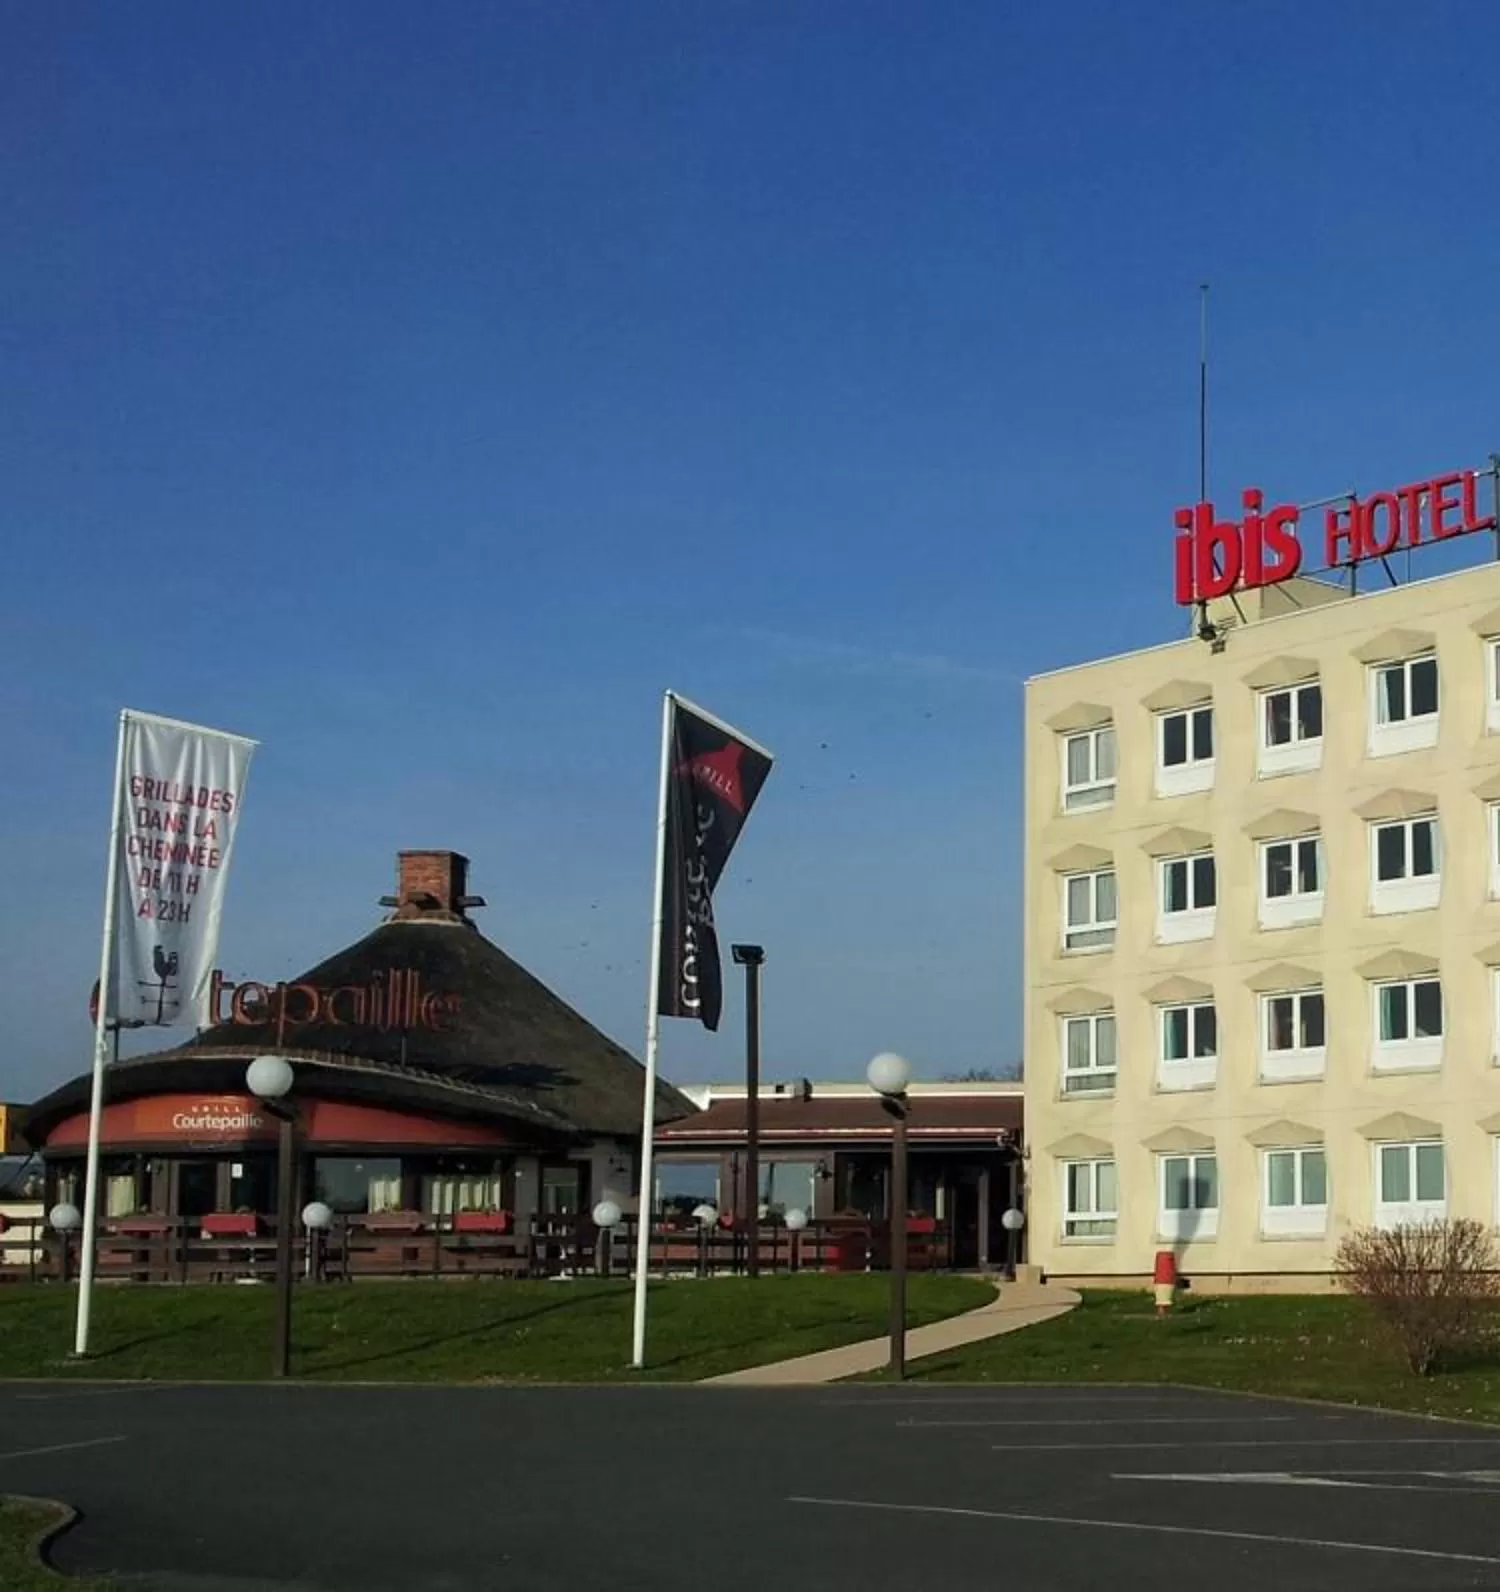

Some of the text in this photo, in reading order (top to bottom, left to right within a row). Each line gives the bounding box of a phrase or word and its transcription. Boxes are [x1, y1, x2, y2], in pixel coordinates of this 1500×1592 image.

[1175, 470, 1497, 606] ibis HOTEL
[131, 775, 235, 813] GRILLADES
[137, 807, 217, 840] DANS LA
[138, 867, 161, 889] DE
[88, 968, 462, 1046] tepaille
[172, 1112, 264, 1132] Courtepaille
